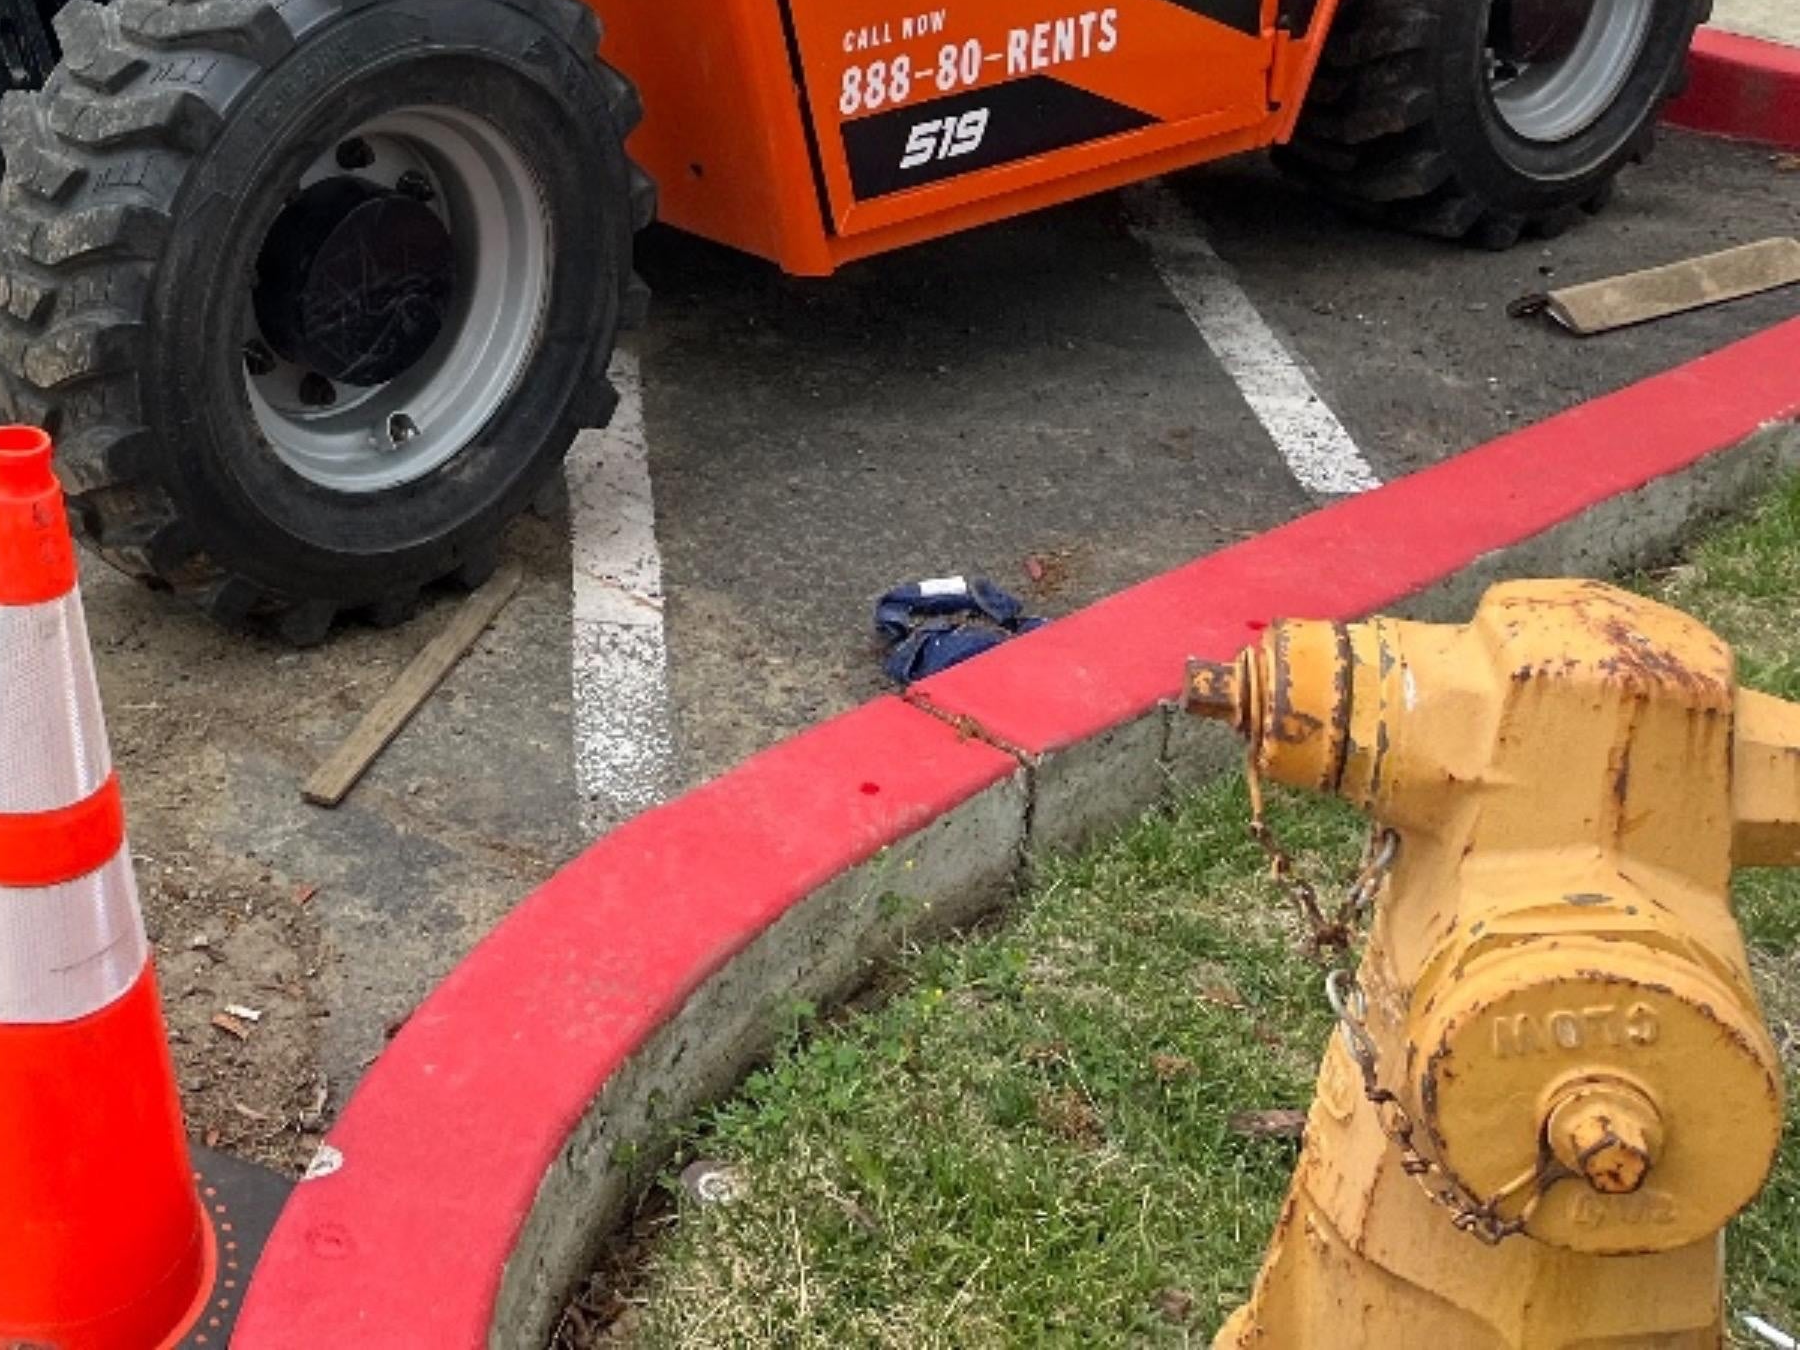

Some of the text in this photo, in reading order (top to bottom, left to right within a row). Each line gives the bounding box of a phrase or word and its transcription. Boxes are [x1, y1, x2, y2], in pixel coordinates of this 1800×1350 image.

[839, 8, 1118, 115] 888-80-RENTS
[843, 8, 947, 52] CALL NOW
[900, 107, 991, 170] 519
